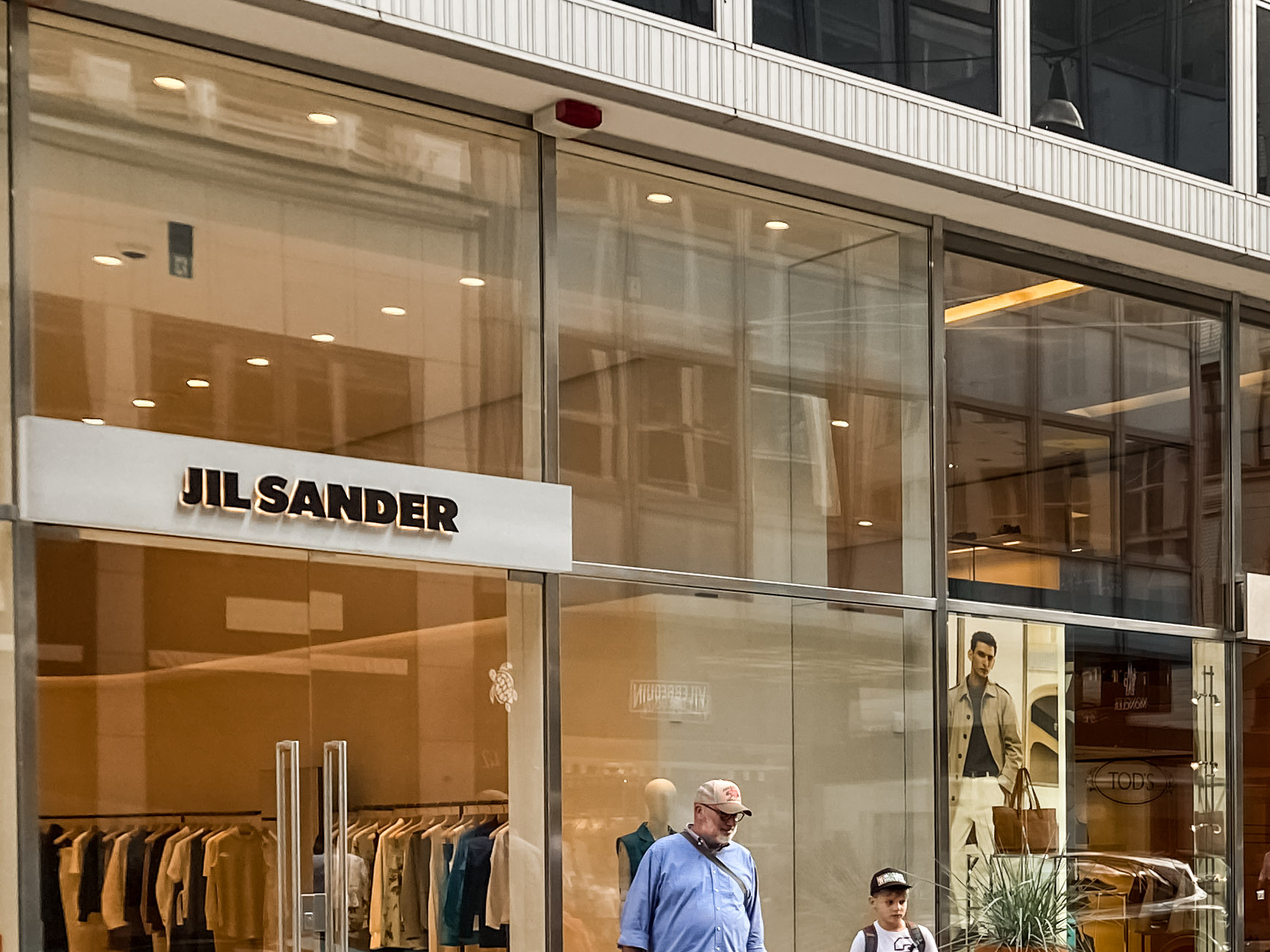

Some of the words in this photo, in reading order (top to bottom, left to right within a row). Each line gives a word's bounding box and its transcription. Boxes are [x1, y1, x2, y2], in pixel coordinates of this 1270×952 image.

[182, 466, 251, 510] JIL
[256, 474, 460, 534] SANDER
[1108, 771, 1154, 792] TOD'S
